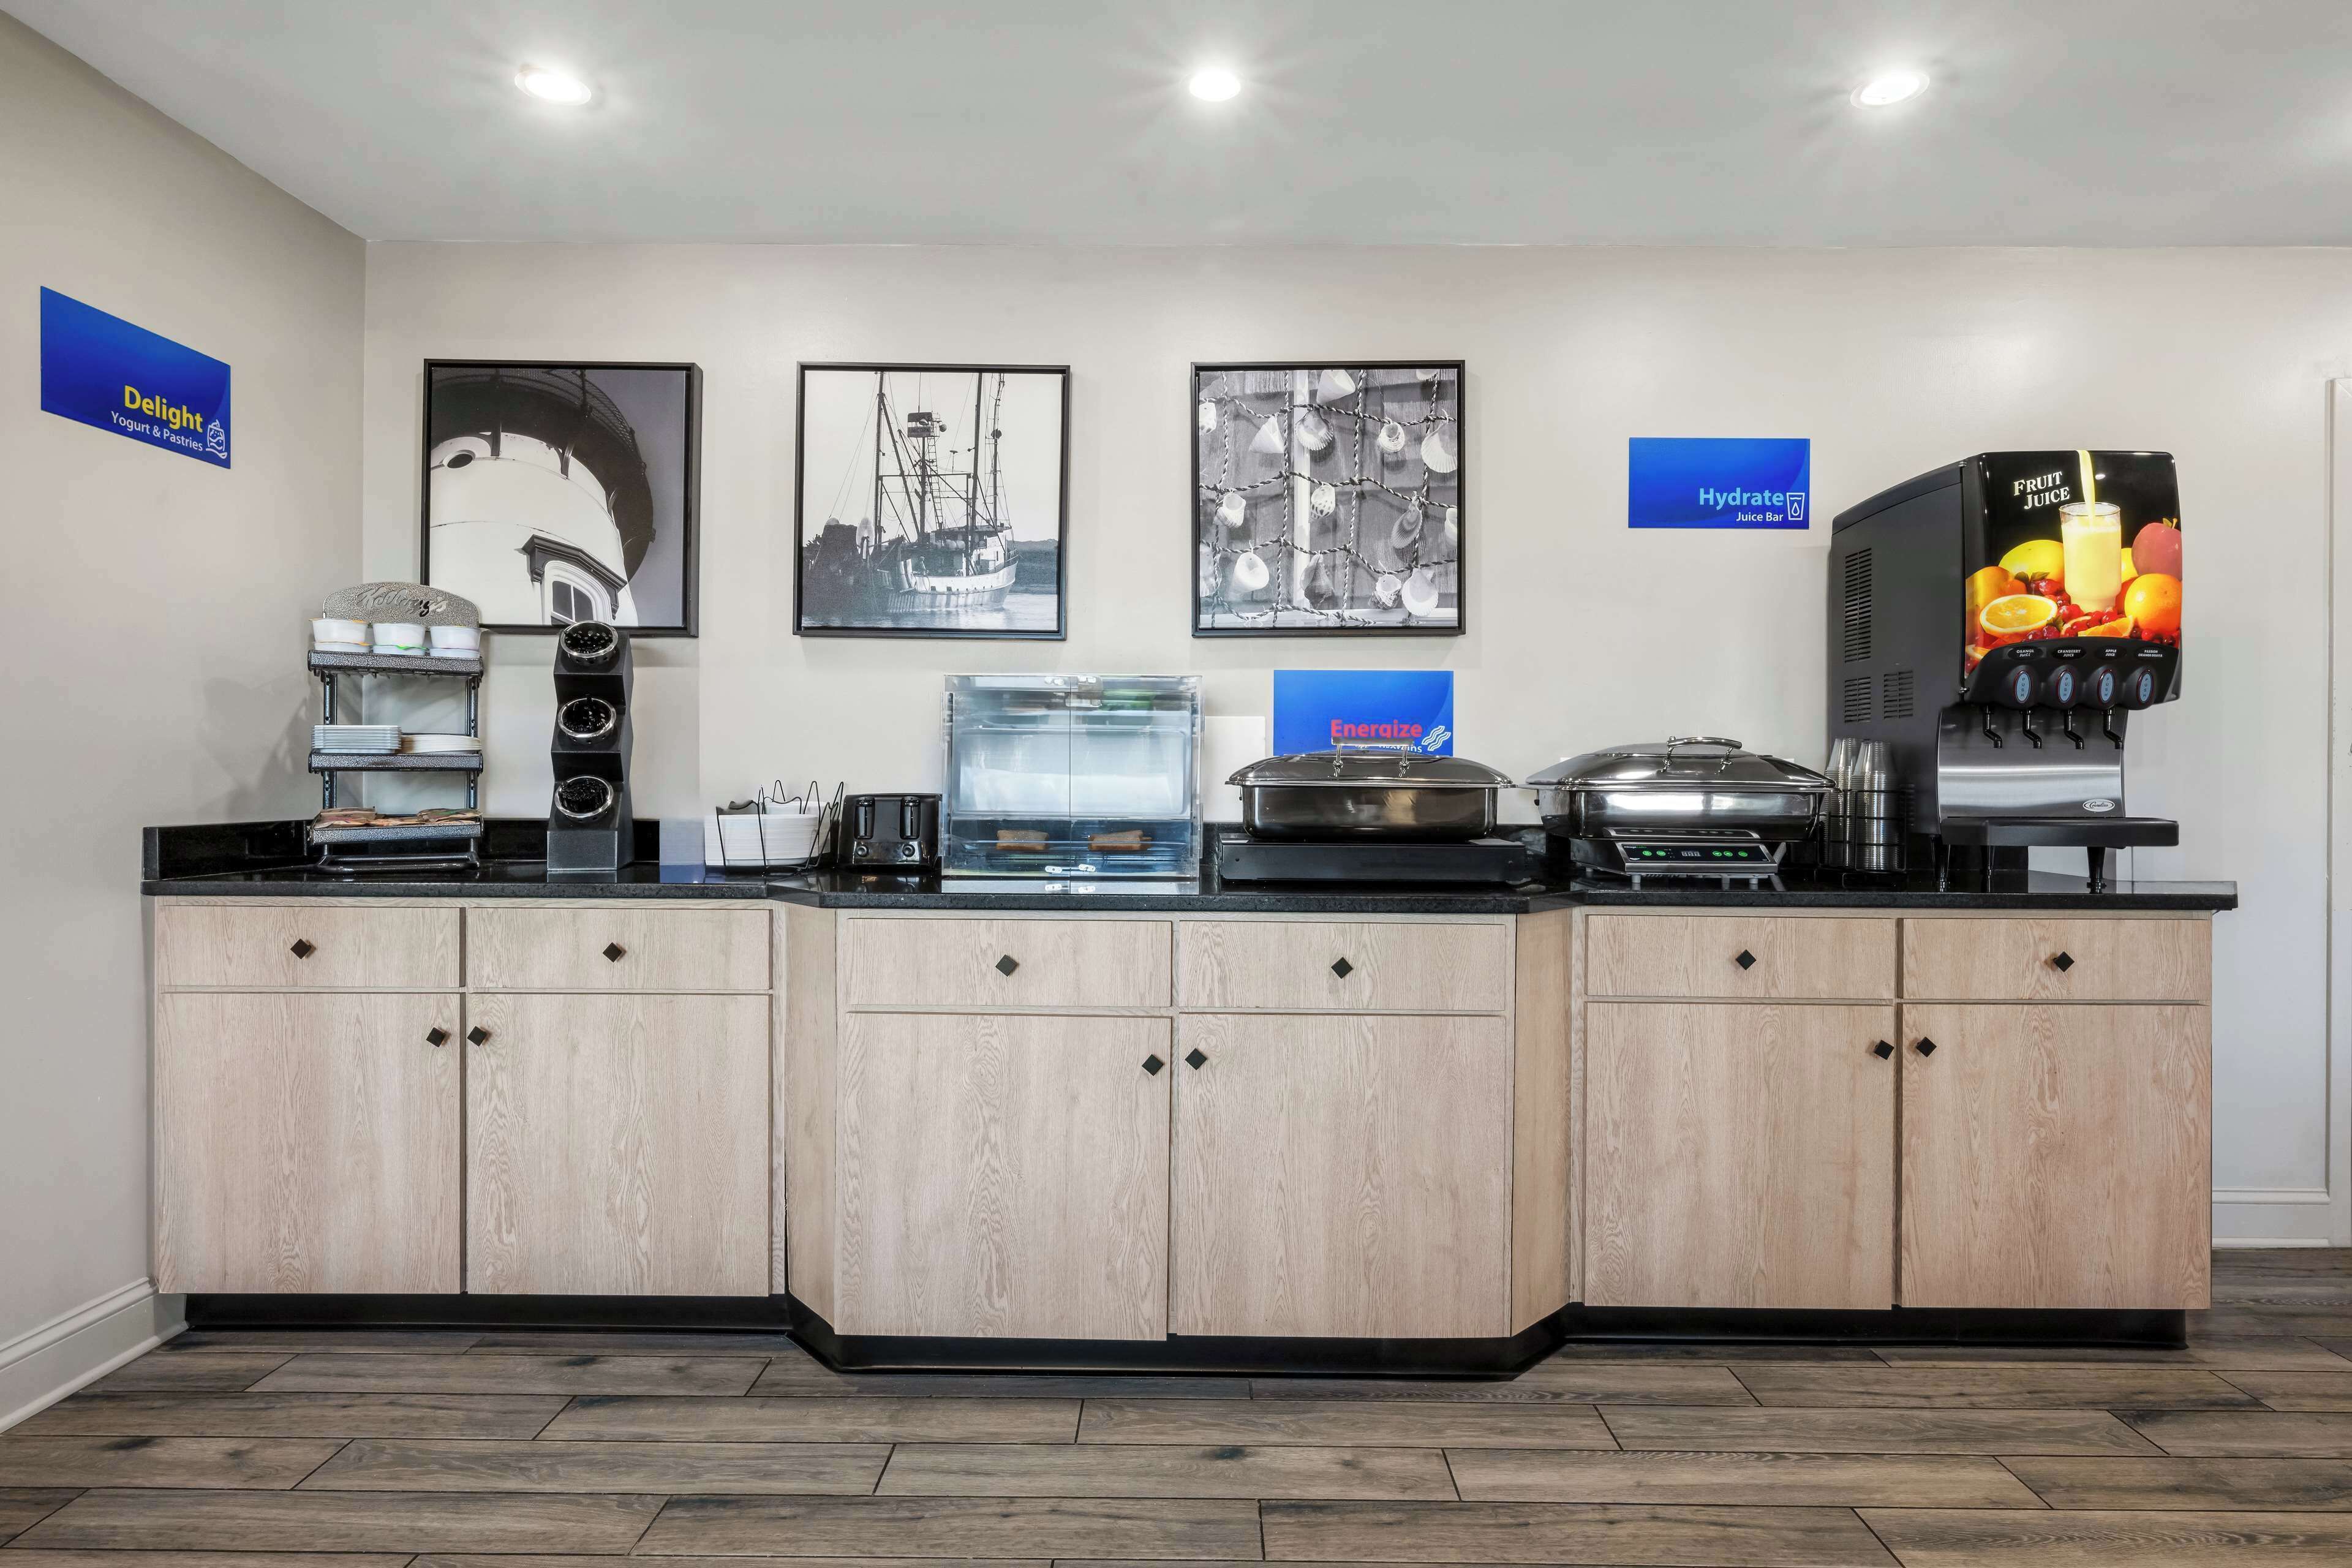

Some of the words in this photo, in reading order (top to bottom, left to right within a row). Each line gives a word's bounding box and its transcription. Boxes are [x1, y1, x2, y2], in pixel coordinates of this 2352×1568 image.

[124, 385, 203, 433] Delight
[111, 410, 151, 434] Yogurt
[153, 425, 161, 438] &
[163, 428, 203, 451] Pastries
[2013, 471, 2062, 496] FRUIT
[1700, 488, 1784, 510] Hydrate
[2024, 486, 2070, 510] JUICE
[1736, 511, 1763, 521] Juice
[1766, 512, 1784, 521] Bar
[1331, 719, 1423, 739] Energize
